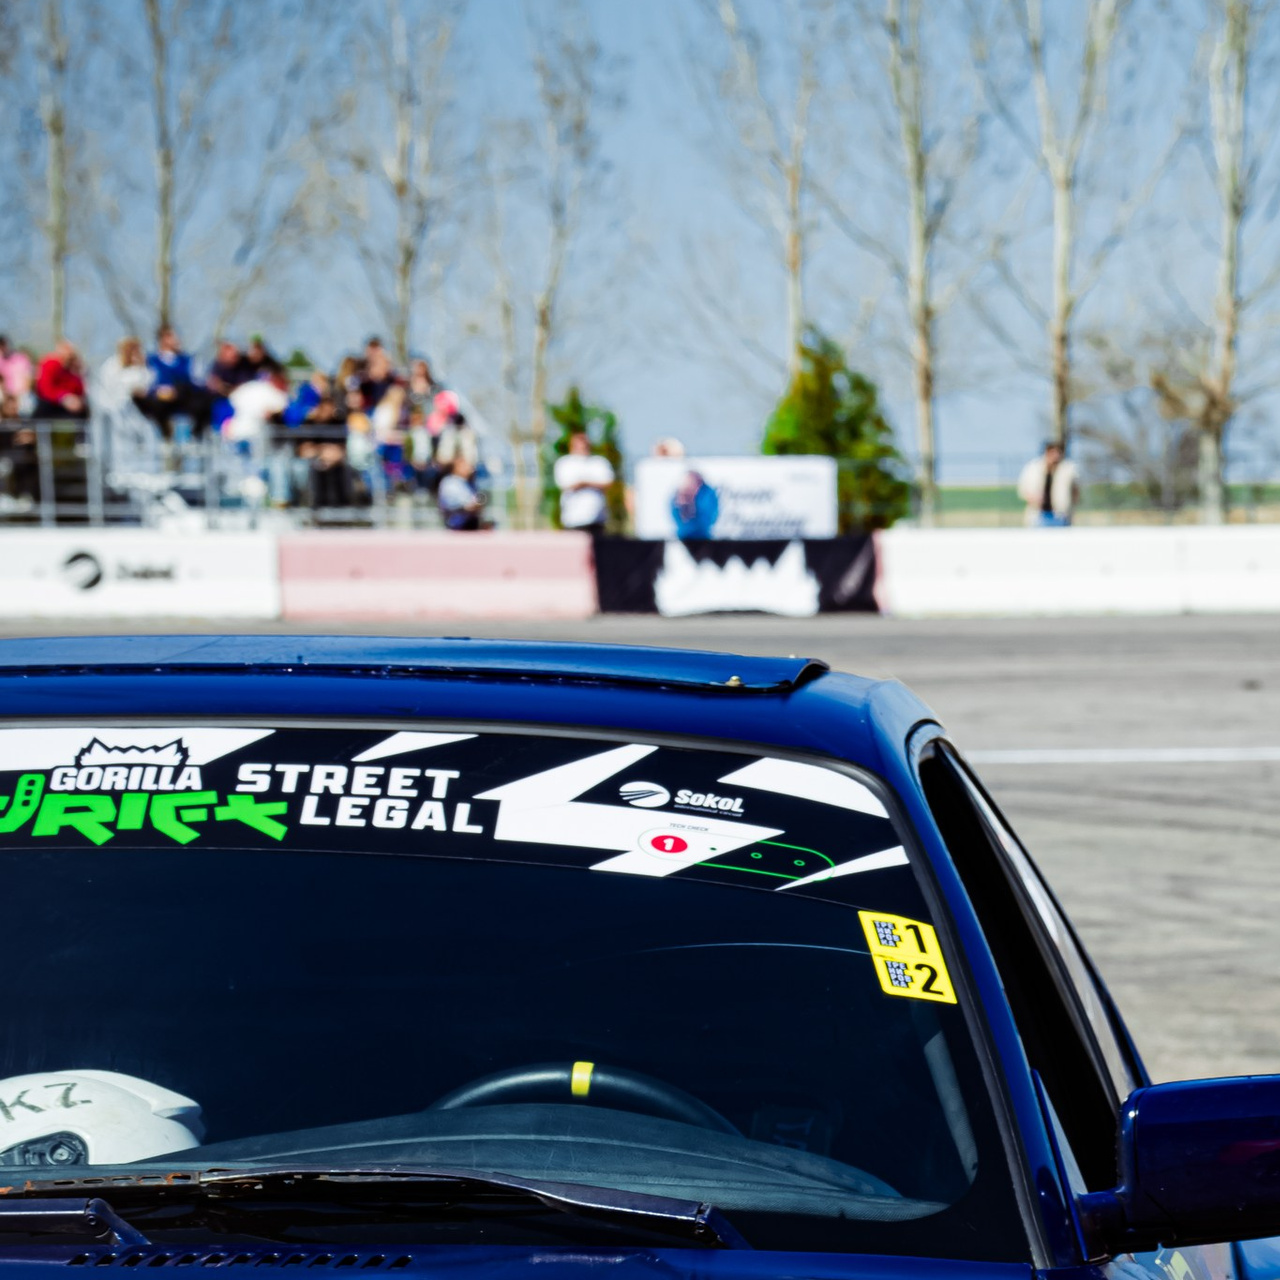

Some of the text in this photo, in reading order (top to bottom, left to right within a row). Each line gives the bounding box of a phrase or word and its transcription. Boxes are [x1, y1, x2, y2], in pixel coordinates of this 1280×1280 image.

[50, 766, 202, 791] GORILLA
[235, 763, 460, 799] STREET
[299, 795, 484, 834] LEGAL
[663, 838, 674, 851] 1
[905, 924, 927, 954] 1
[915, 963, 944, 995] 2
